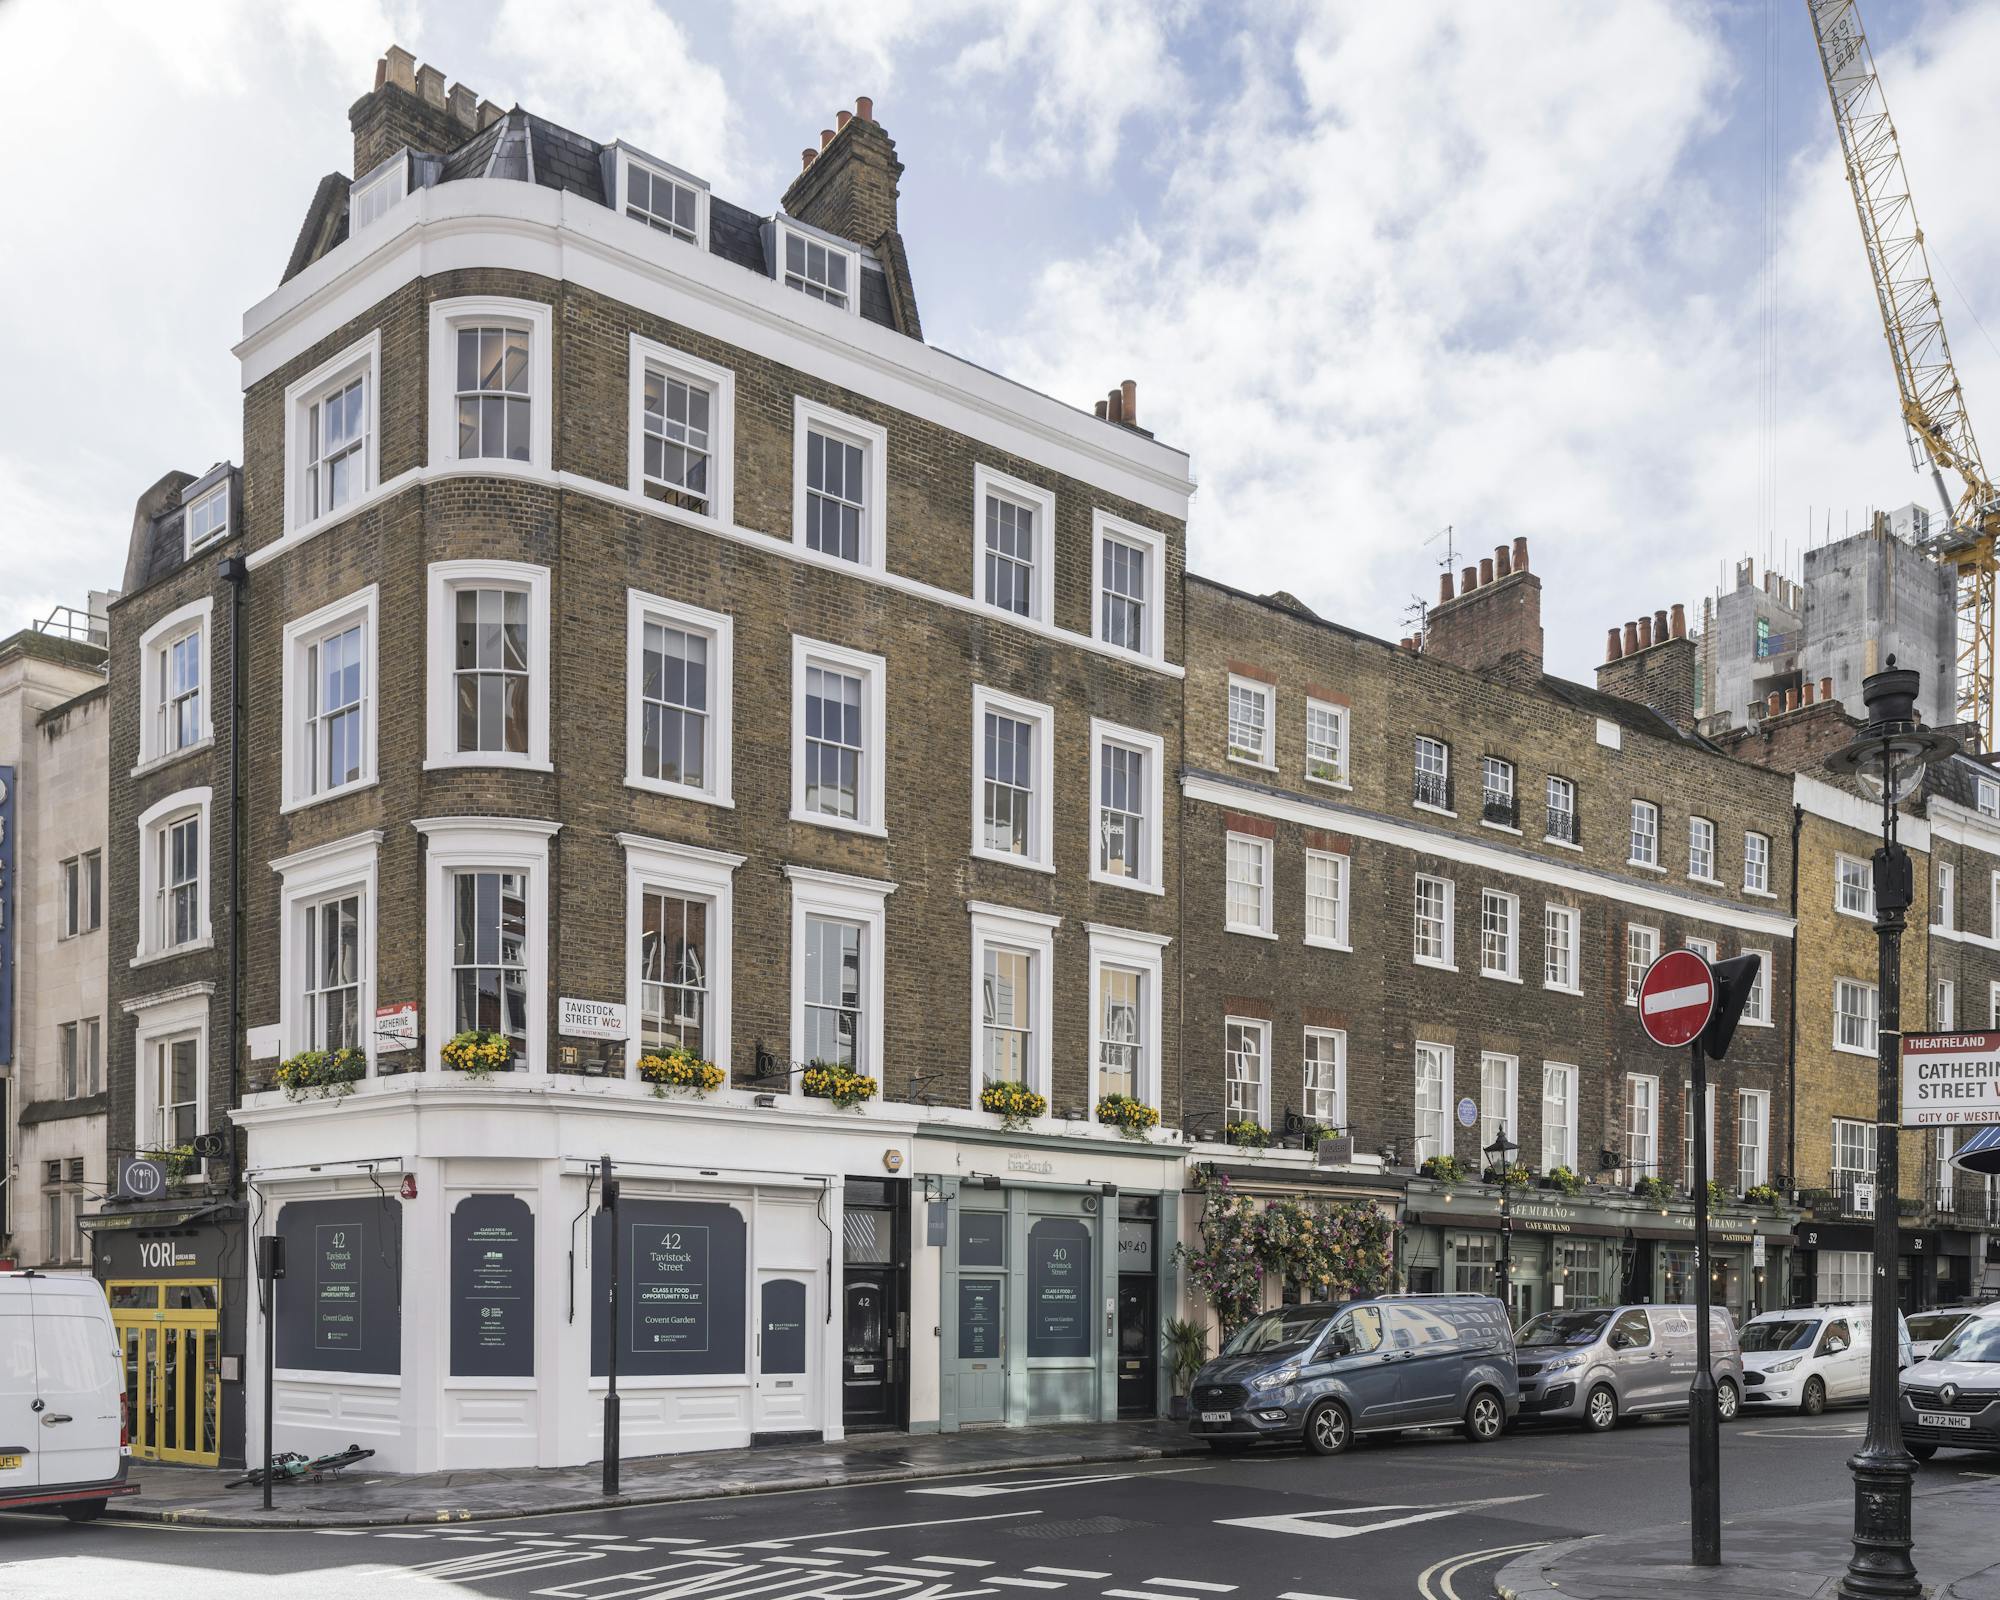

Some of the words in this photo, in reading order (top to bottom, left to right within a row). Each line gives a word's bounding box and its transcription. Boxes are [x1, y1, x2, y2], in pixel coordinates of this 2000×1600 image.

[565, 1002, 614, 1016] TAVISTOCK
[379, 1016, 408, 1029] CATHERINE
[565, 1014, 598, 1026] STREET
[602, 1017, 621, 1028] WC2
[1909, 1037, 1985, 1048] THEATRELAND
[1919, 1082, 1987, 1099] STREET
[1919, 1113, 1942, 1122] CITY
[1946, 1112, 1960, 1121] OF
[1510, 1205, 1527, 1215] AFE
[1529, 1206, 1567, 1218] MURANO
[1525, 1221, 1542, 1229] CAFE
[1541, 1222, 1571, 1232] MURANO
[1708, 1219, 1736, 1229] URANO
[332, 1232, 345, 1248] 42
[661, 1233, 681, 1249] 42
[1809, 1233, 1817, 1243] 32
[1914, 1239, 1922, 1249] 32
[140, 1242, 175, 1267] YORI
[326, 1252, 351, 1260] Tavistock
[650, 1252, 691, 1261] Tavistock
[1053, 1249, 1066, 1260] 40
[330, 1261, 346, 1270] Street
[658, 1262, 683, 1271] Street
[859, 1298, 870, 1307] 42
[338, 1314, 354, 1322] Garden
[645, 1316, 670, 1324] Covent
[670, 1316, 696, 1324] Garden
[1948, 1417, 1967, 1426] NHC
